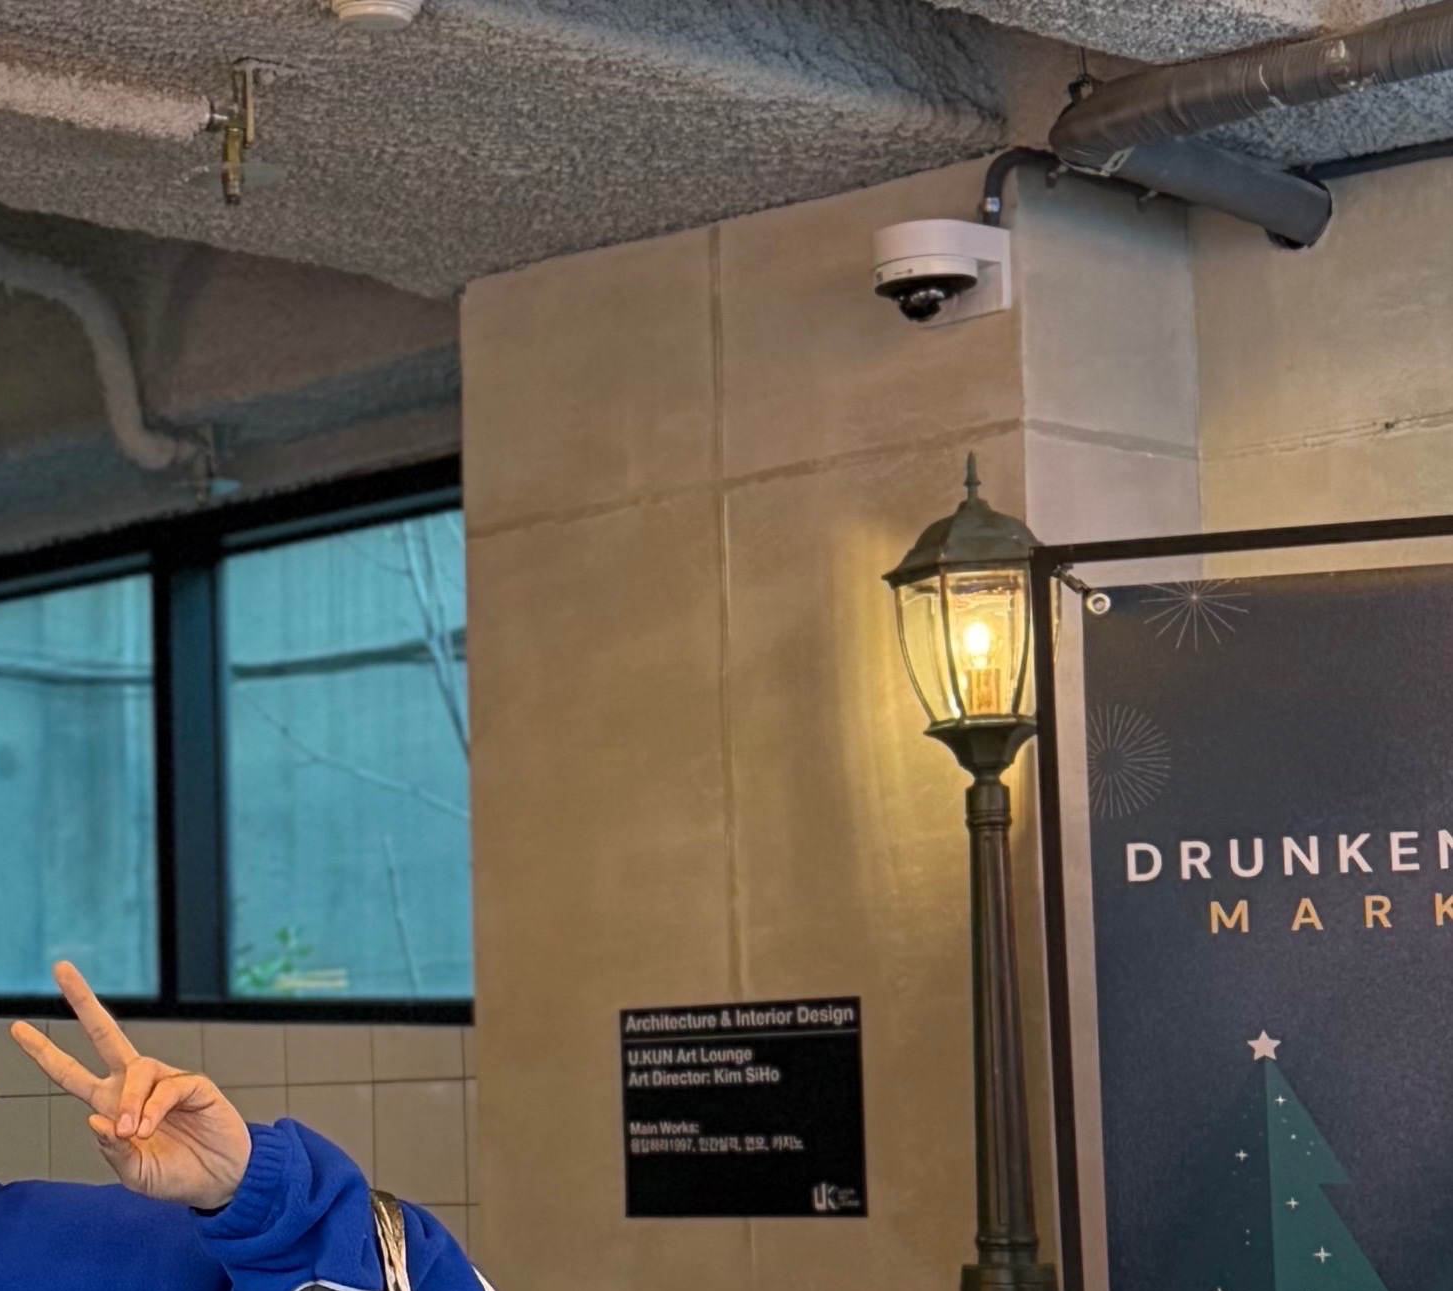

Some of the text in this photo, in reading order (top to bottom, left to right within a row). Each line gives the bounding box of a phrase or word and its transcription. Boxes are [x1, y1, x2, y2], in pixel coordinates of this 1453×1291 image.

[625, 1005, 854, 1033] Architecture & Interior Design
[676, 1048, 697, 1064] Art
[700, 1047, 752, 1065] Lounge
[628, 1067, 780, 1087] Art Director: Kim SiHo
[630, 1122, 657, 1135] Main
